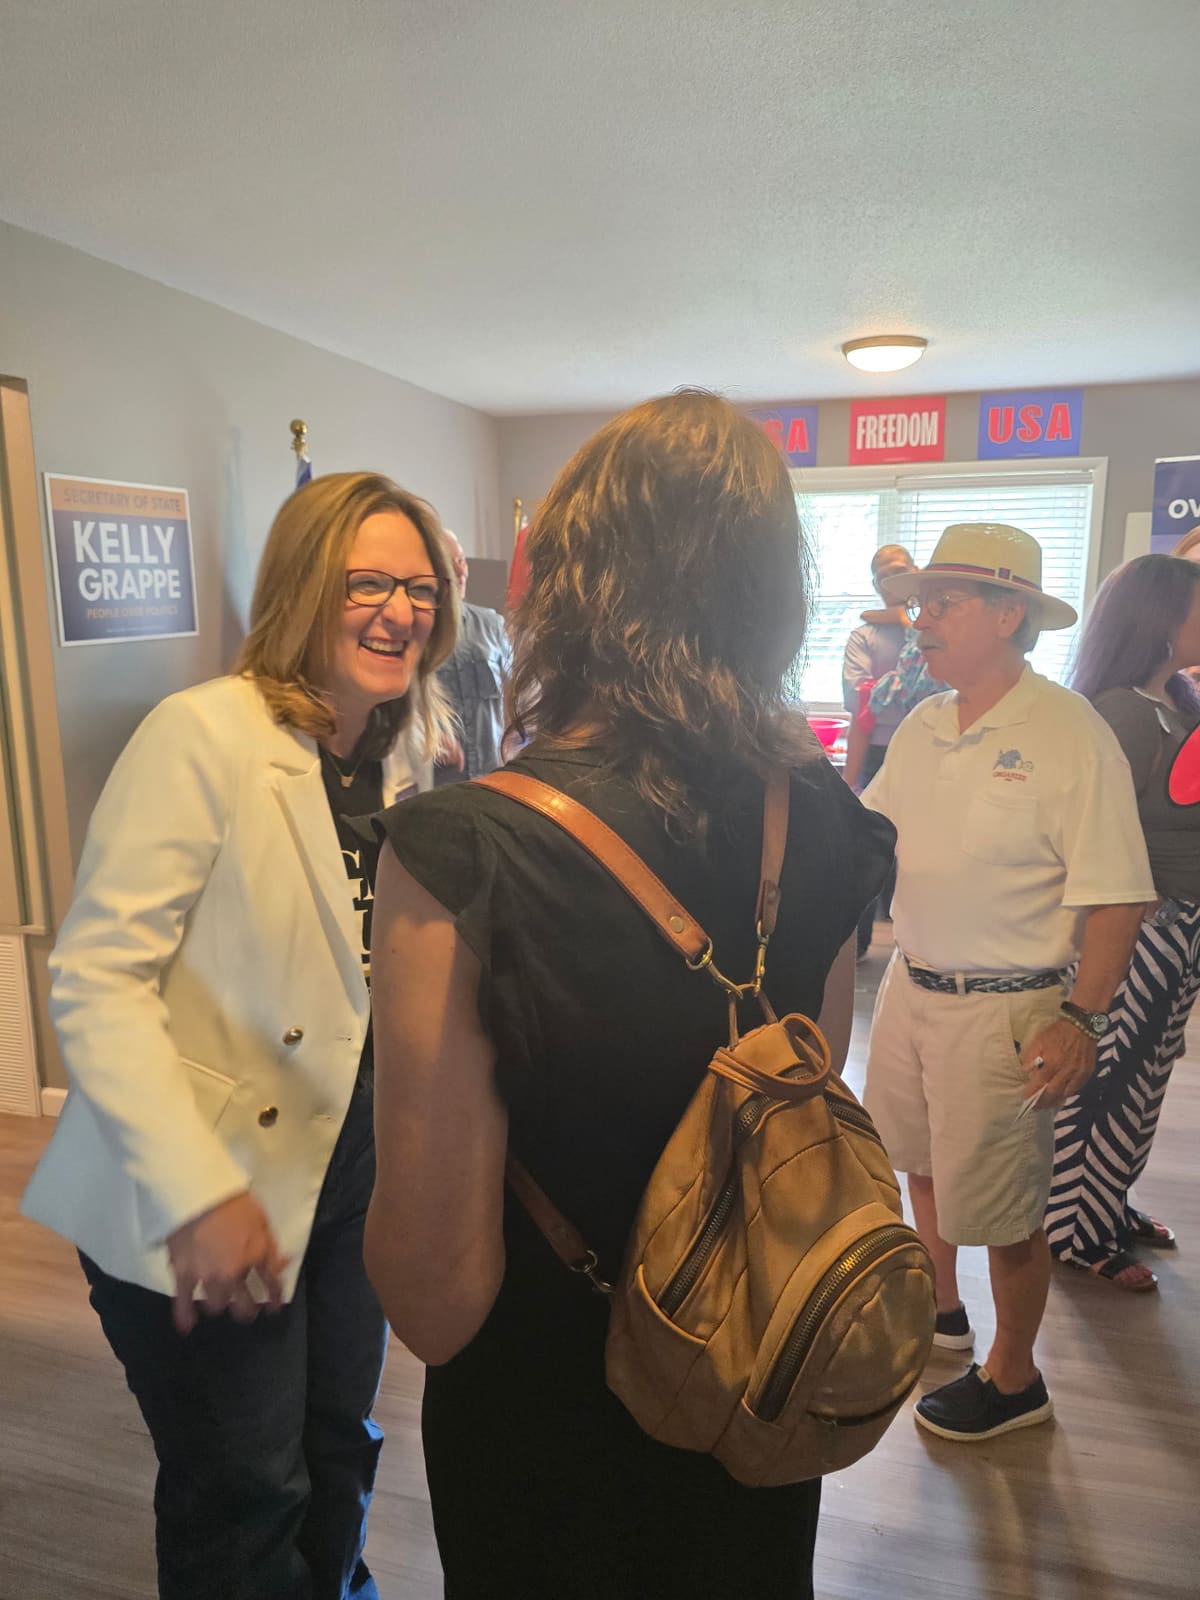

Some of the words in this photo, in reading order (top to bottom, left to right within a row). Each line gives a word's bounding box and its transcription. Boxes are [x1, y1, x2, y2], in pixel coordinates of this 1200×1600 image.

[754, 417, 810, 453] SA
[856, 411, 939, 450] FREEDOM
[988, 402, 1072, 444] USA
[63, 487, 130, 508] SECRETARY
[134, 493, 148, 509] OF
[151, 497, 182, 512] STATE
[72, 519, 175, 565] KELLY
[78, 567, 182, 602] GRAPPE
